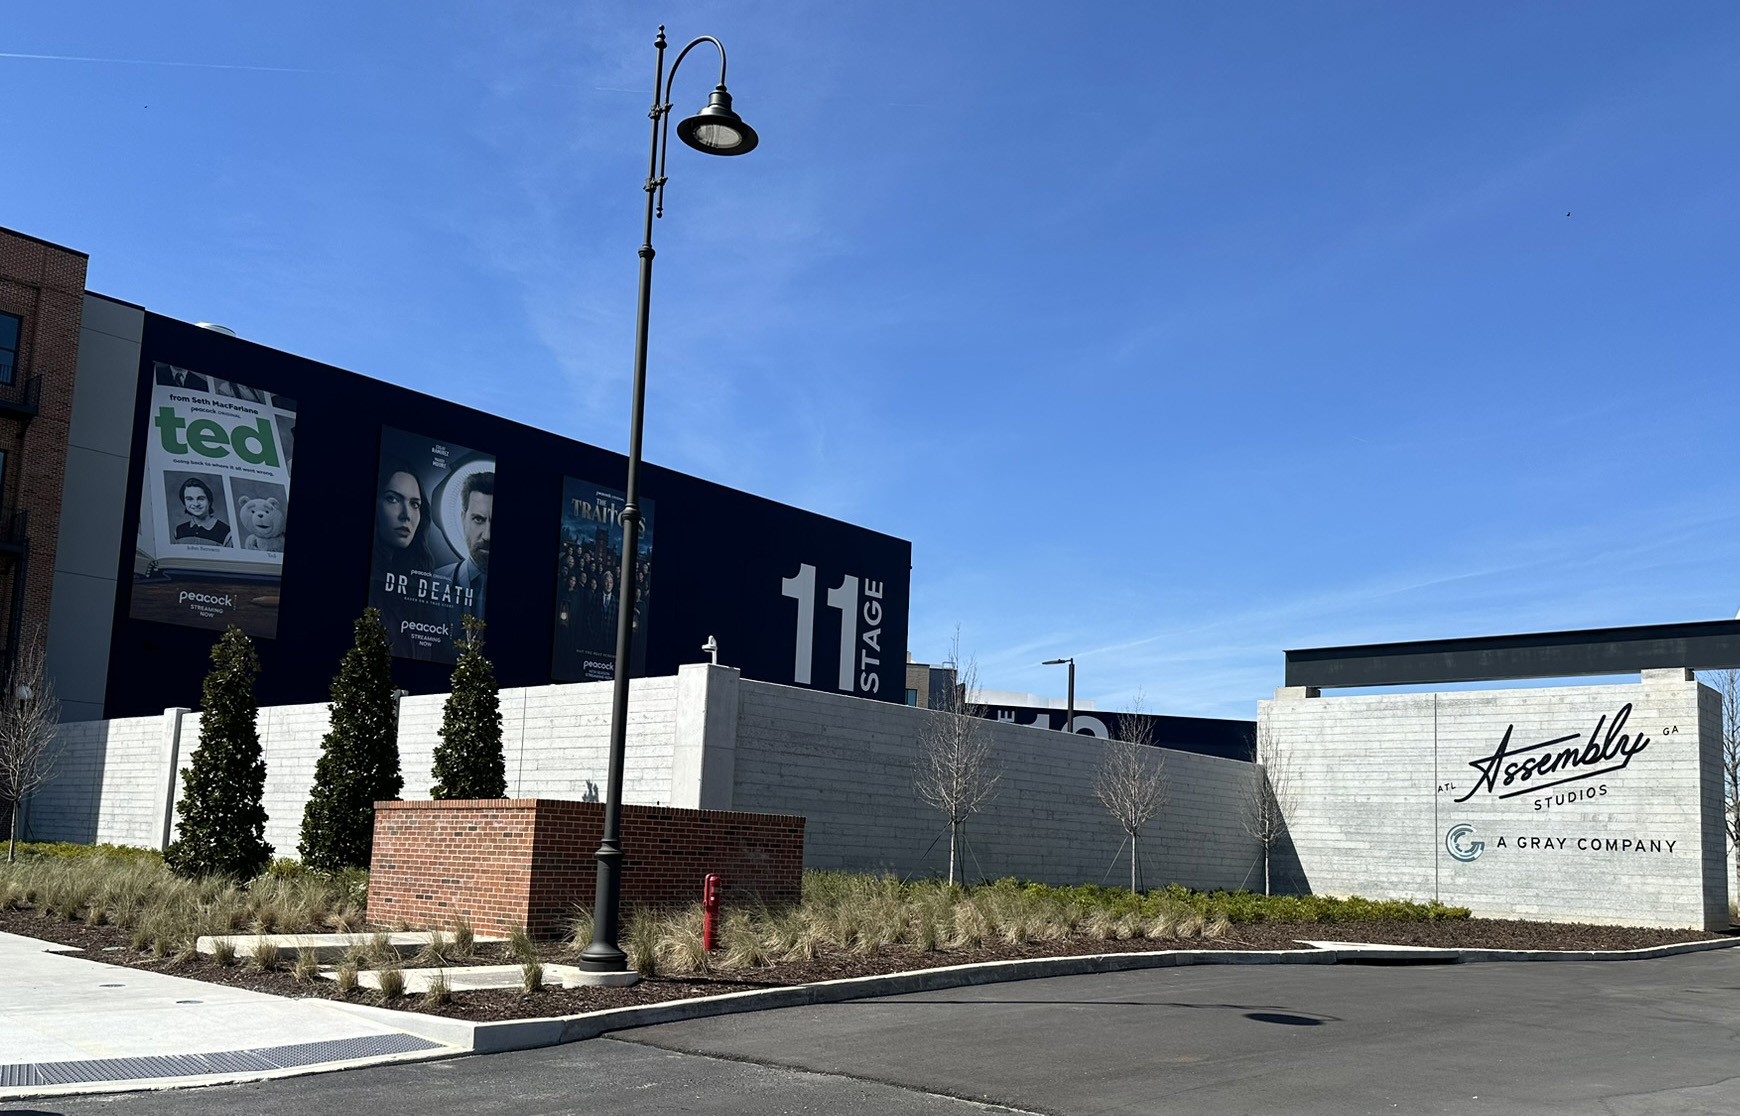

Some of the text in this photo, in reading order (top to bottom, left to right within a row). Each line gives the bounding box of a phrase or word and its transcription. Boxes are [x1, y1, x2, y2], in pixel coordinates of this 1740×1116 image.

[170, 394, 259, 415] from Seth MacFarlane
[190, 406, 216, 414] peacock
[154, 406, 280, 468] ted
[572, 498, 646, 534] TRAITS
[410, 569, 432, 577] peacock
[385, 573, 474, 607] DR DEATH
[179, 590, 232, 607] peacock
[190, 604, 224, 614] STREAMING
[401, 620, 449, 635] peacock
[782, 562, 859, 692] 11
[411, 633, 441, 643] STREAMING
[860, 578, 883, 694] STAGE
[583, 660, 614, 671] peacock
[1662, 725, 1679, 736] GA
[1454, 703, 1650, 802] Assembly
[1438, 782, 1456, 793] ATL
[1534, 784, 1607, 811] STUDIOS
[1497, 836, 1676, 852] A GRAY COMPANY
